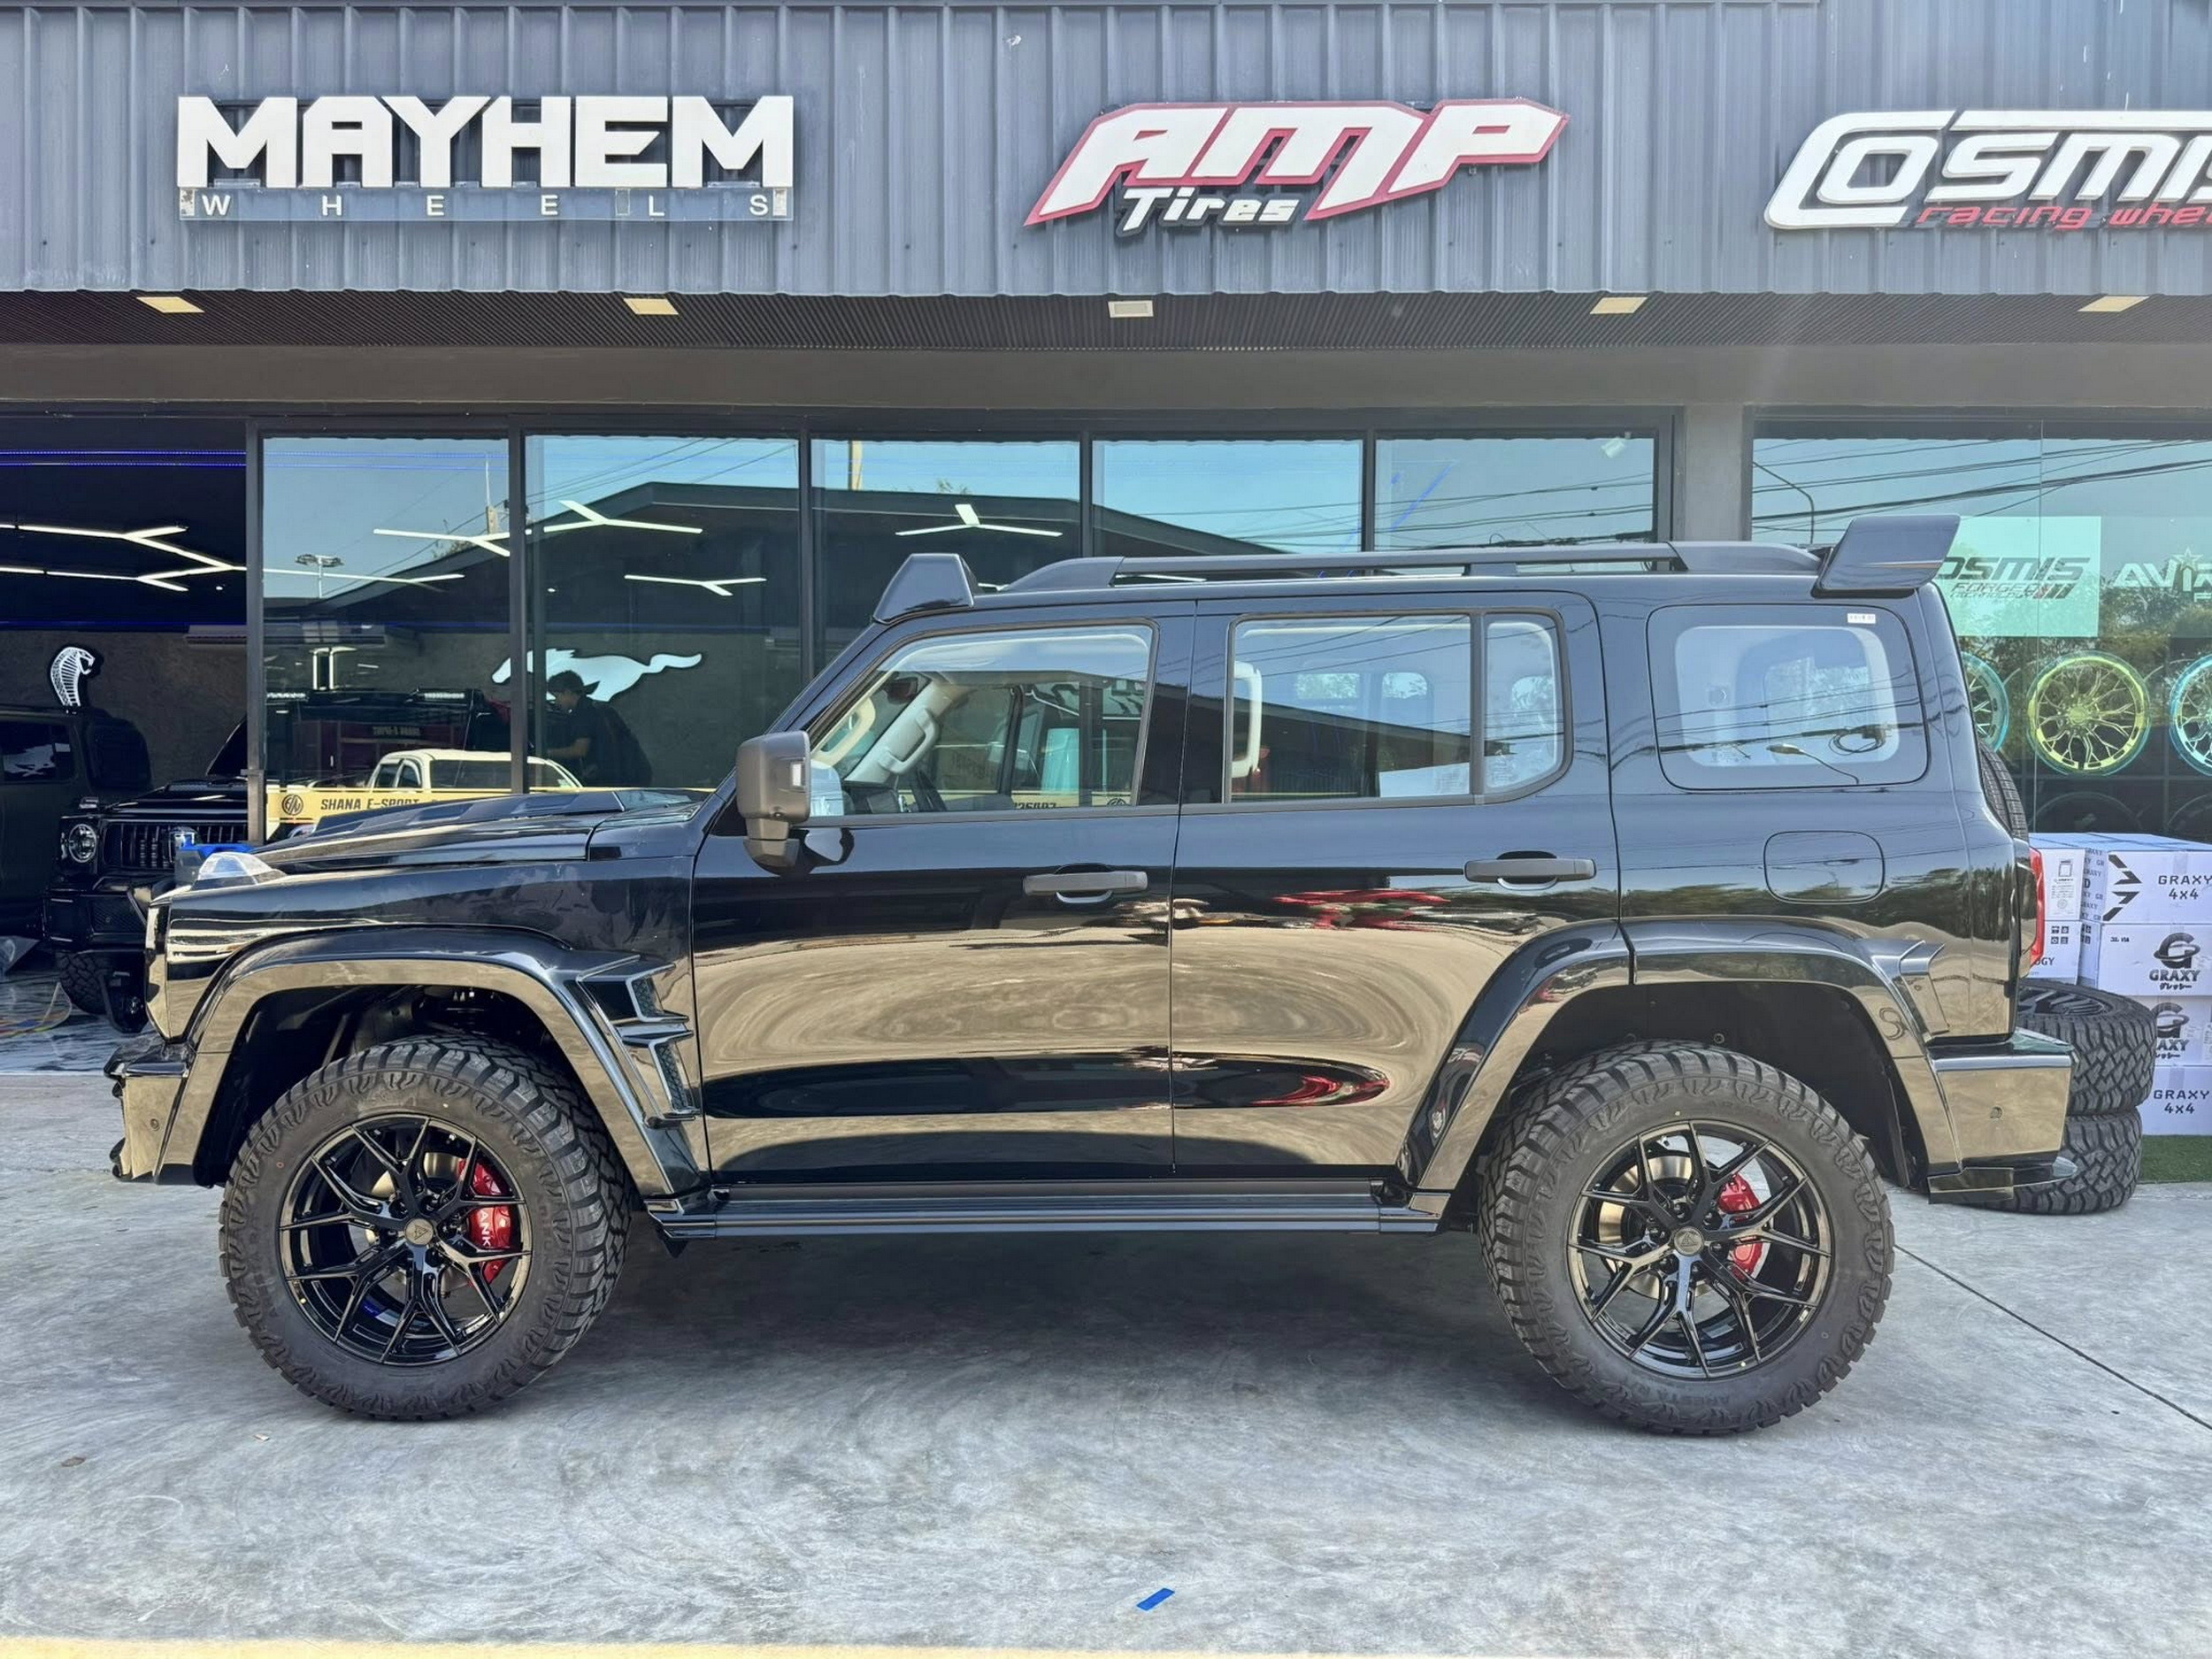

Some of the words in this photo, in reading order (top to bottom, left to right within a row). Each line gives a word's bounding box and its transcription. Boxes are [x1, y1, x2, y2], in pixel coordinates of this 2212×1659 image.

[177, 96, 794, 188] MAYHEM
[1024, 100, 1571, 227] AMP
[1764, 110, 2212, 230] COSMI
[201, 194, 769, 217] WHEELS
[1122, 188, 1300, 232] Tires
[1916, 204, 2092, 231] racing
[2108, 203, 2212, 226] whe
[1935, 557, 2091, 580] OSMIS
[320, 798, 362, 811] SHANA
[2158, 874, 2212, 885] GRAXY
[2168, 887, 2199, 900] 4x4
[2148, 969, 2201, 982] GRAXY
[2156, 1039, 2190, 1052] AXY
[2153, 1089, 2210, 1100] GRAXY
[2163, 1102, 2195, 1114] 4x4
[480, 1208, 492, 1248] ANK
